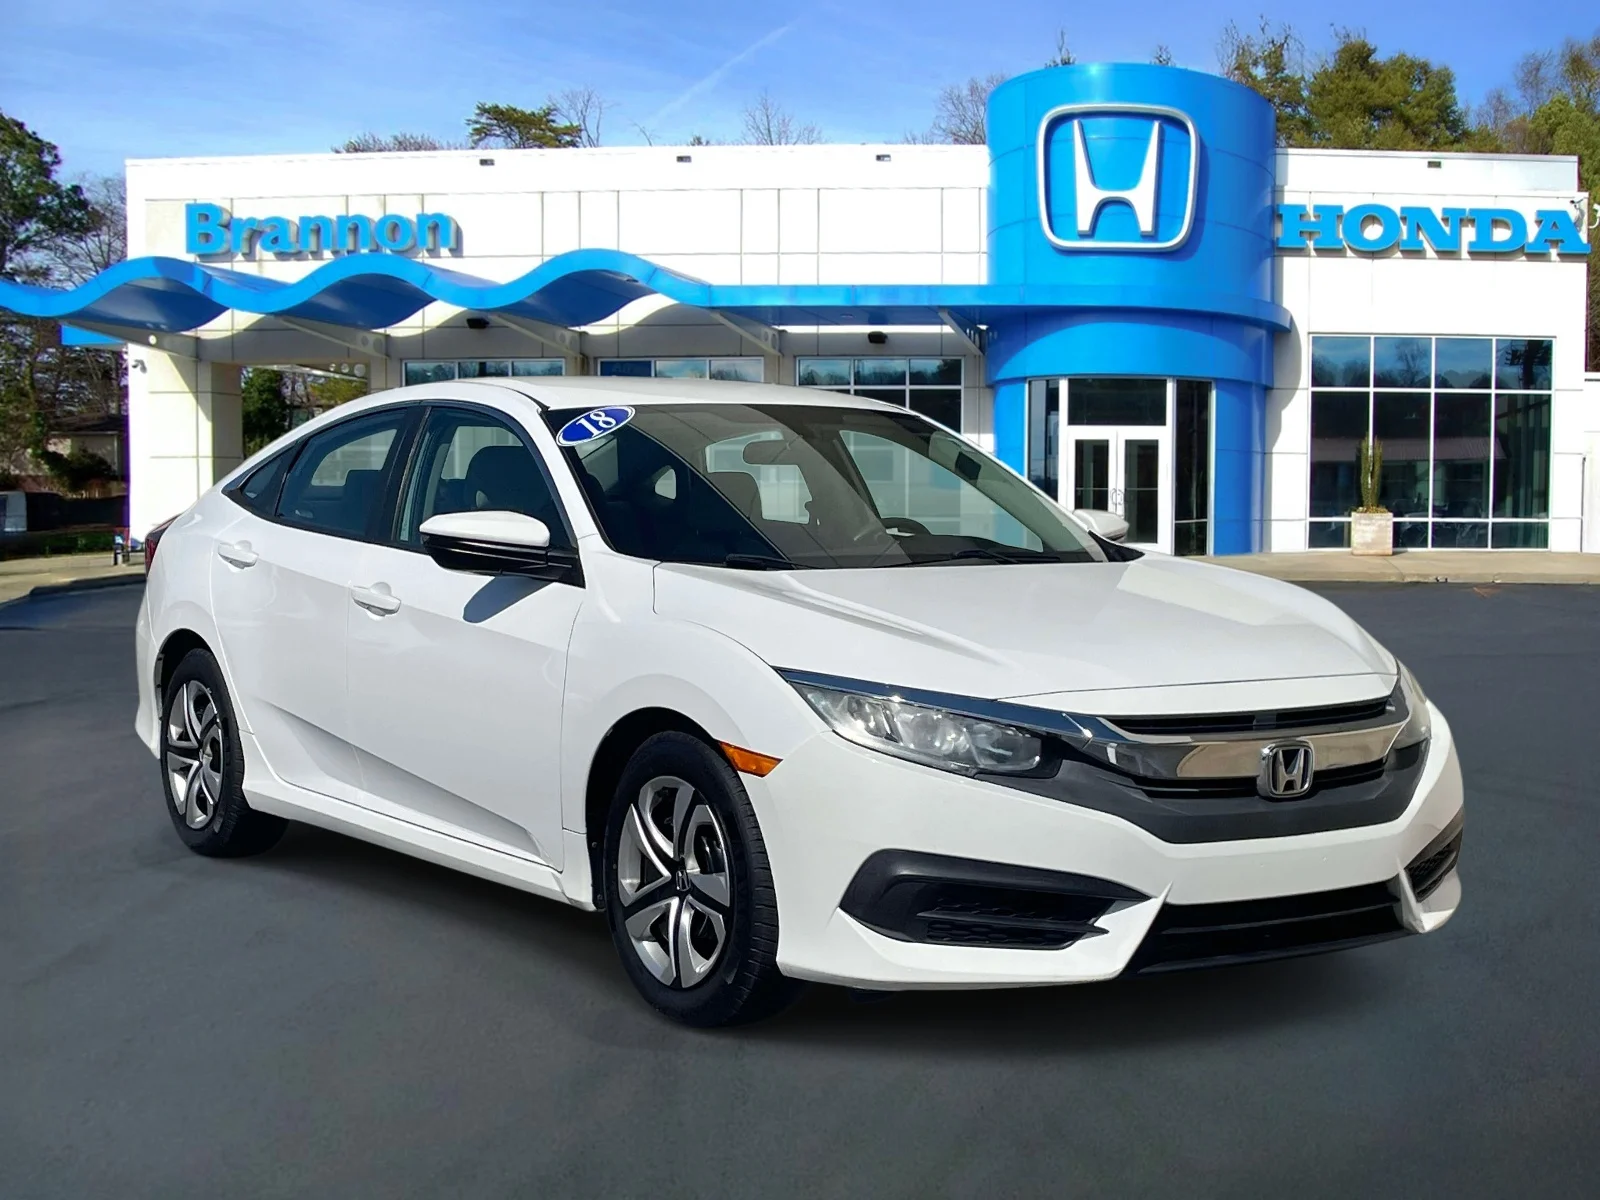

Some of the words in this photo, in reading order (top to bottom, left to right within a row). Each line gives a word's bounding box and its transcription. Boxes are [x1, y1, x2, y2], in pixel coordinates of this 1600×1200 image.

[185, 203, 457, 254] Brannon
[1276, 204, 1591, 255] HONDA
[576, 411, 616, 437] 18
